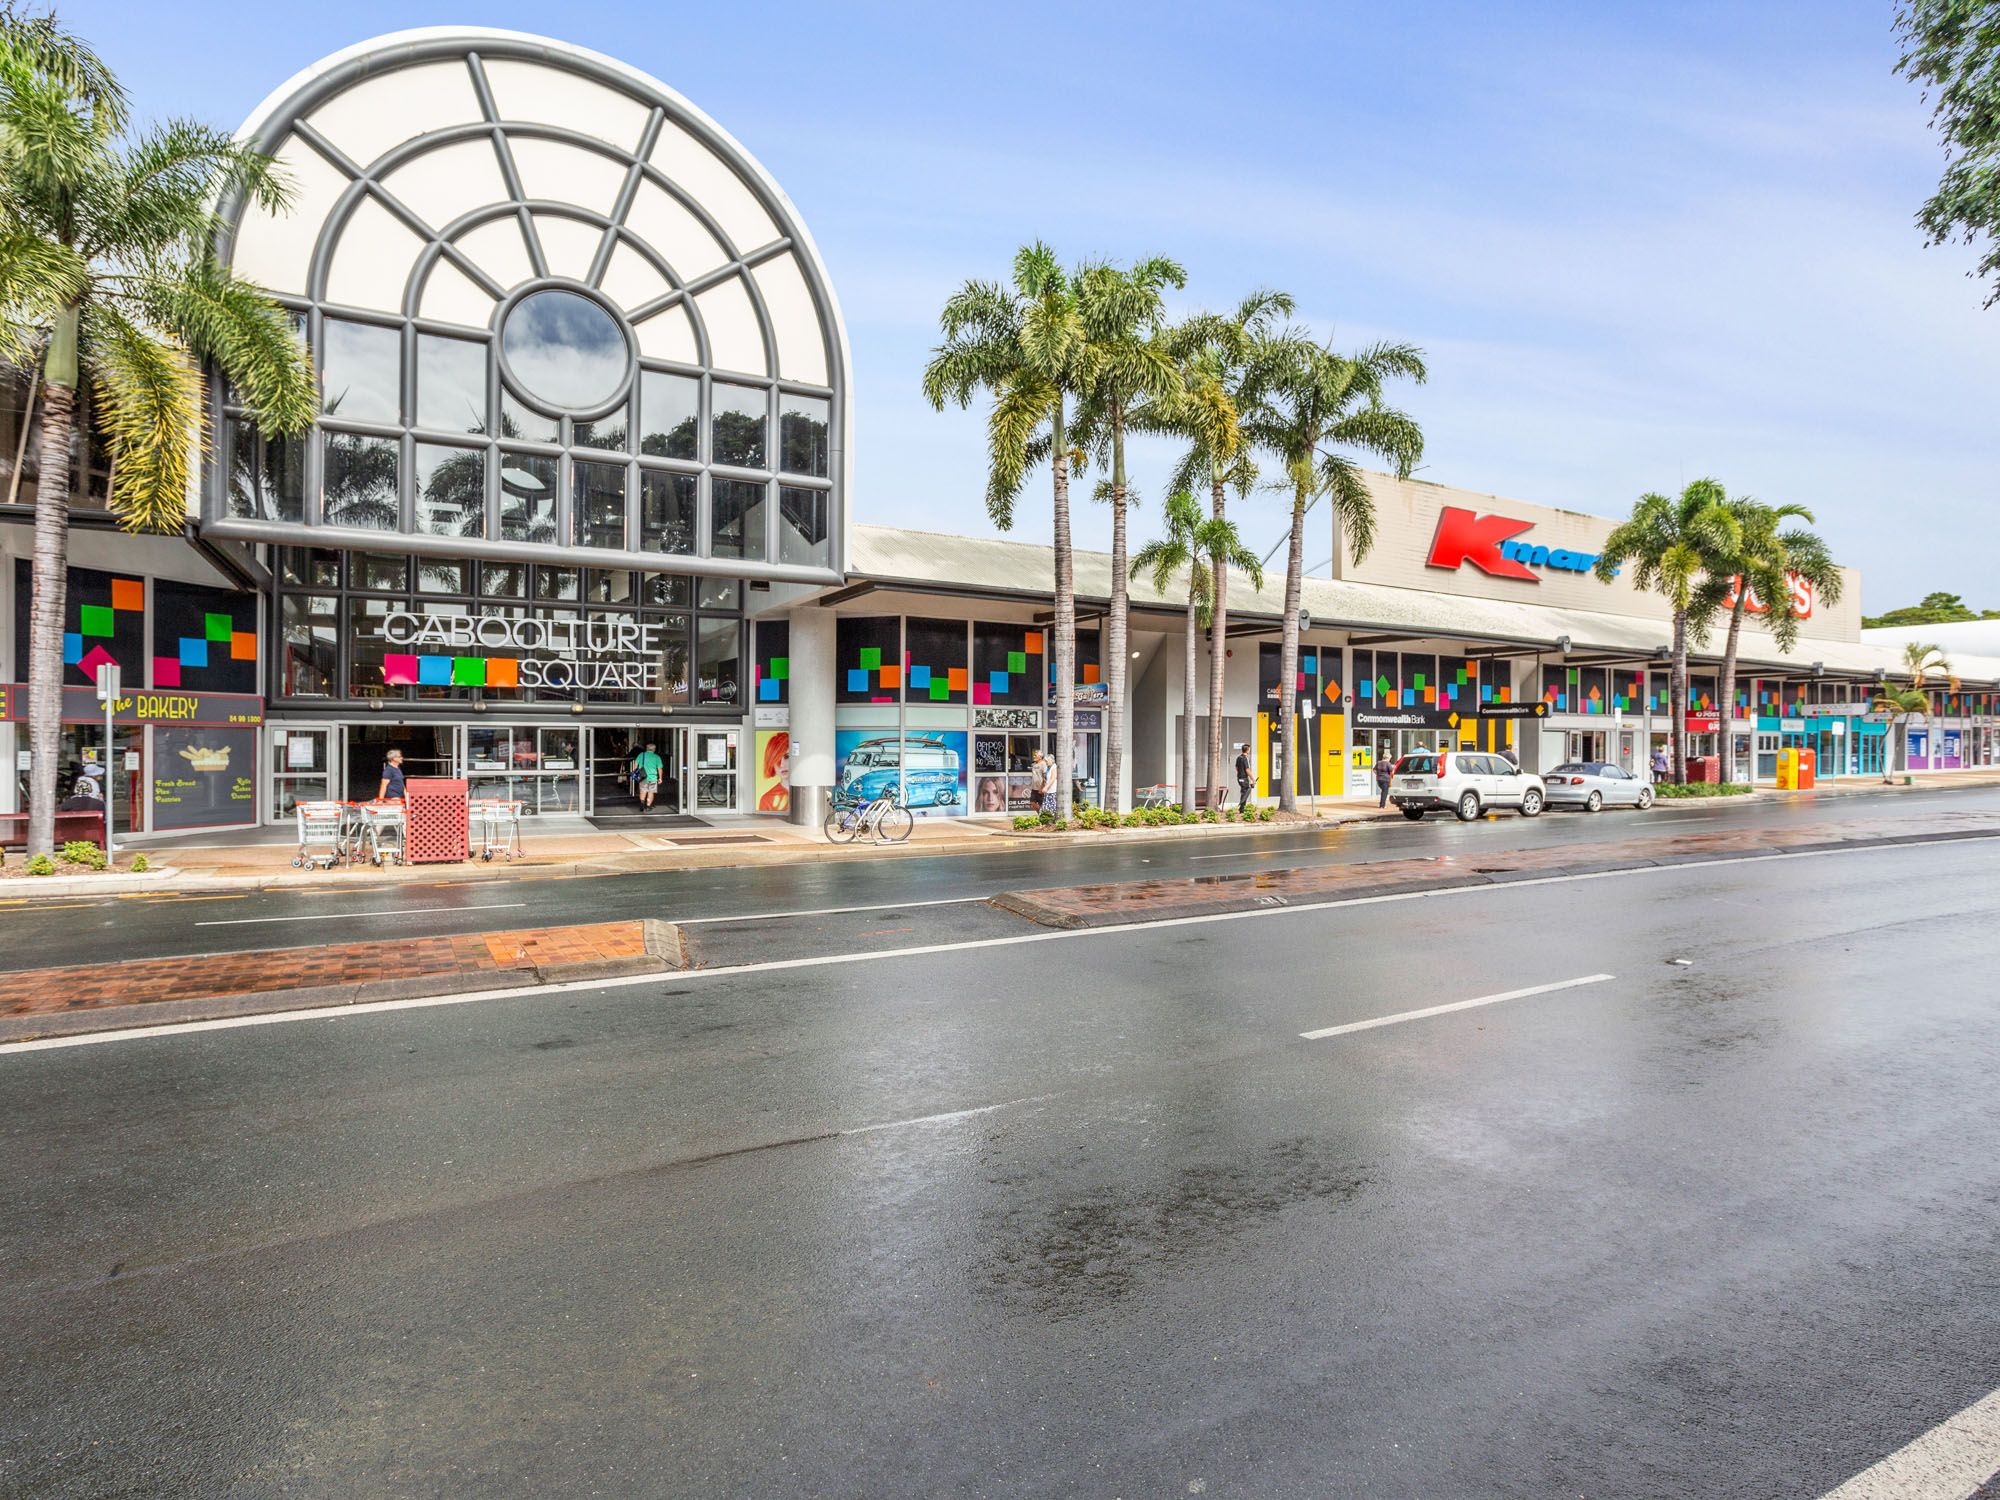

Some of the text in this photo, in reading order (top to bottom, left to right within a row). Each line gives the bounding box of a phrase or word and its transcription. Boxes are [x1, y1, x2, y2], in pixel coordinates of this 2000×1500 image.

[1426, 506, 1621, 583] Kmar
[383, 612, 660, 654] CABOOLTURE
[520, 659, 661, 690] SQUARE
[137, 695, 198, 719] BAKERY
